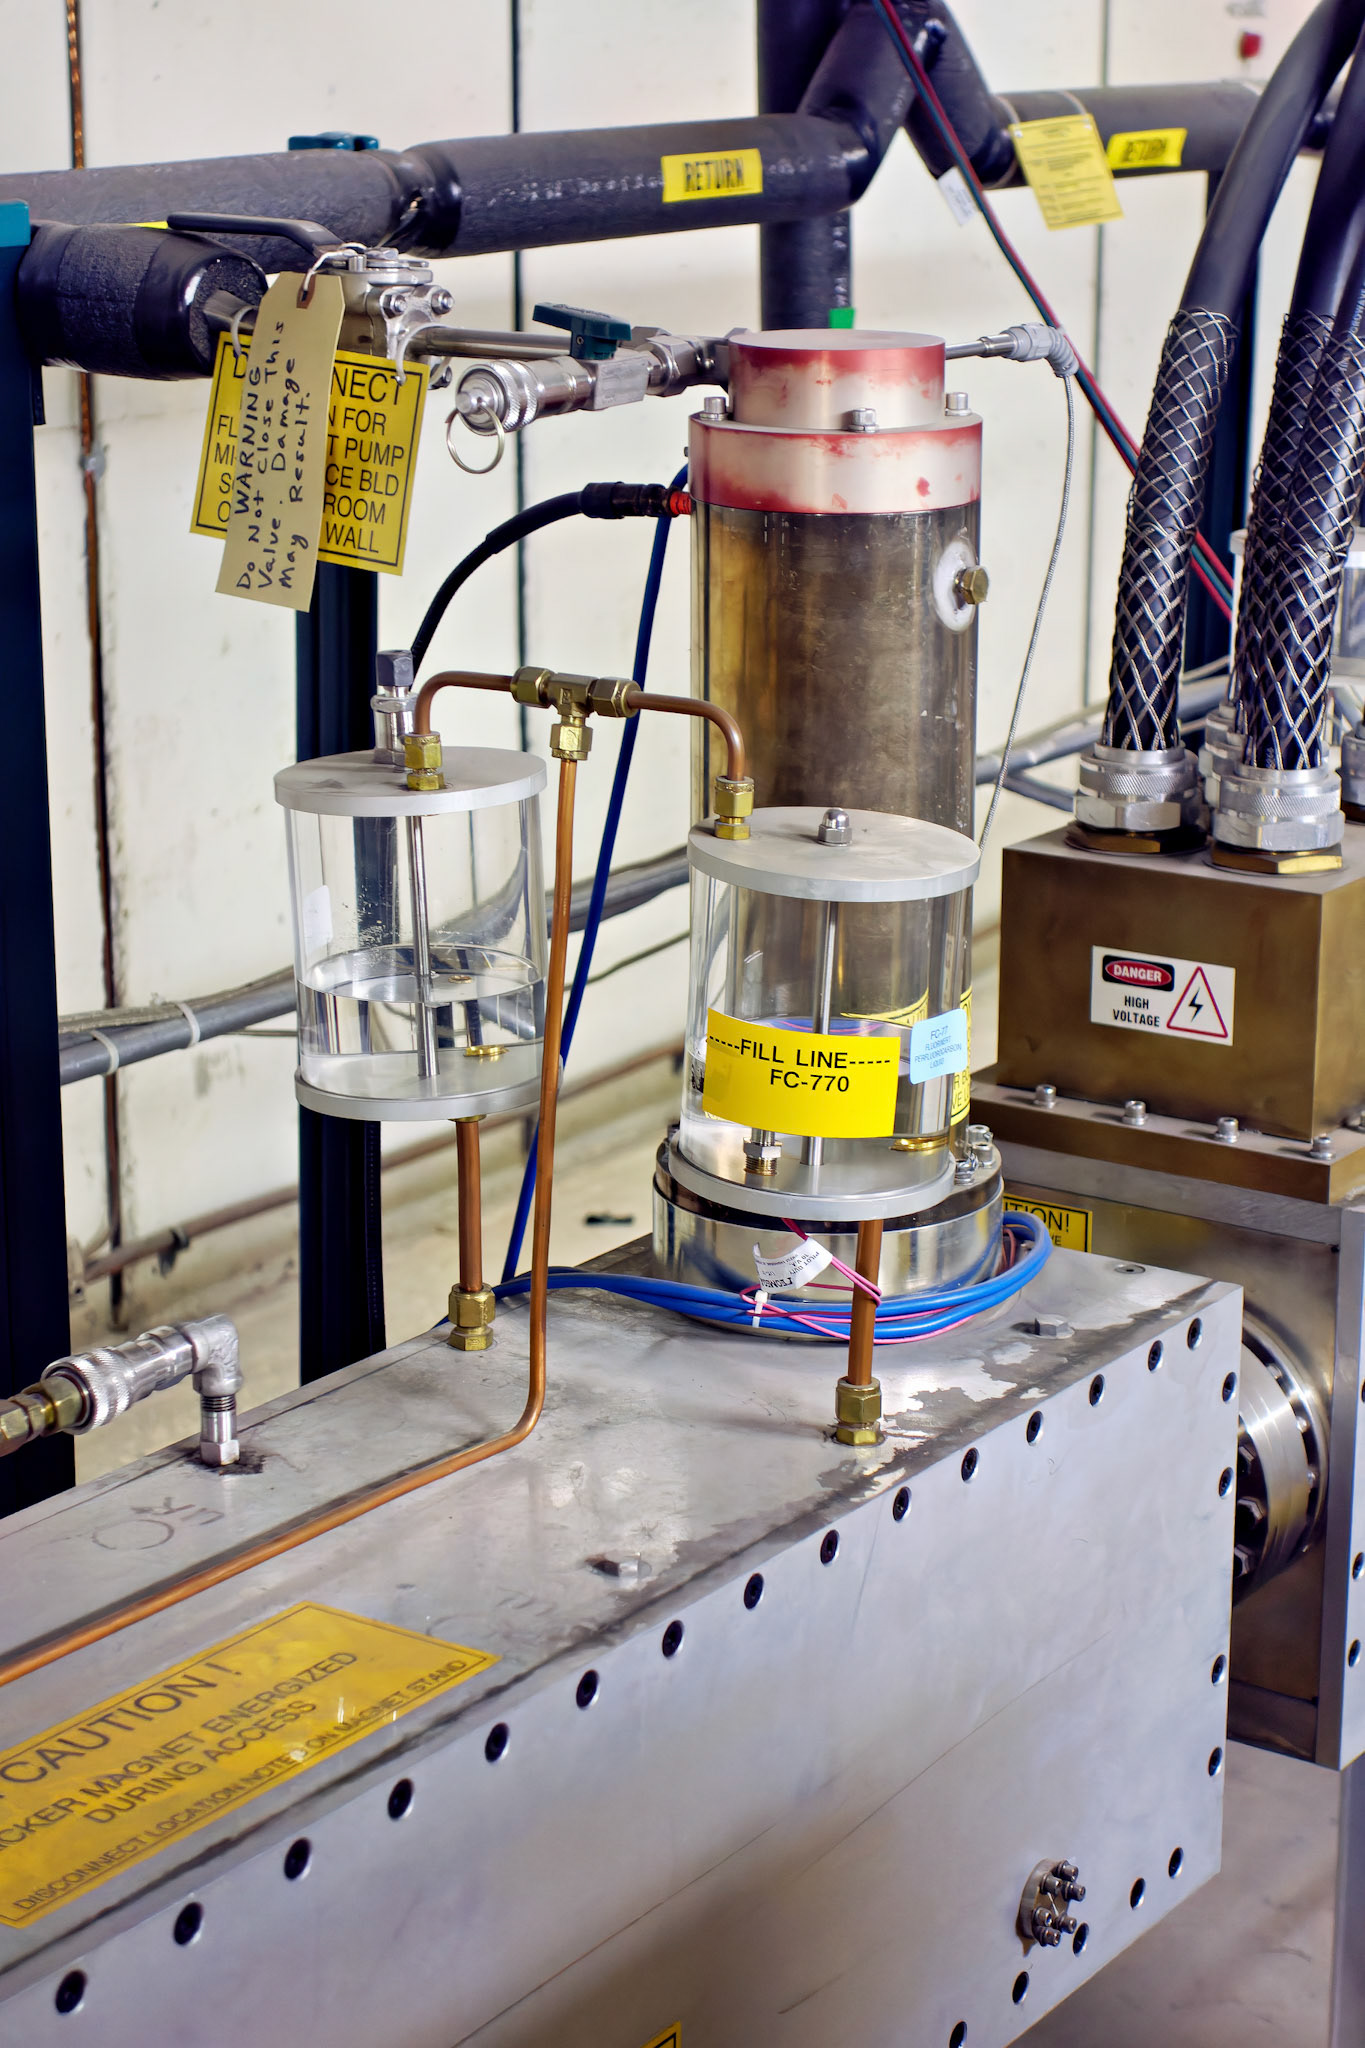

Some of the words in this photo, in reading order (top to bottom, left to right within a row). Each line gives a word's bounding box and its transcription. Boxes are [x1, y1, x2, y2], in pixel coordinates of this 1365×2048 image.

[684, 157, 745, 192] RETURN
[264, 321, 284, 384] This
[271, 358, 300, 471] Damage
[343, 407, 387, 436] FOR
[235, 366, 261, 515] WARNING
[257, 399, 274, 474] Close
[345, 437, 405, 467] PUMP
[359, 469, 400, 497] BLD
[248, 489, 265, 543] Not
[322, 492, 387, 525] ROOM
[325, 521, 380, 554] WALL
[236, 561, 256, 589] Do
[279, 533, 310, 589] May
[1113, 964, 1162, 983] DANGER
[1112, 1008, 1160, 1028] VOLTAGE
[1124, 995, 1150, 1010] HIGH
[930, 1025, 949, 1040] FC-77
[770, 1068, 850, 1093] FC-770
[79, 1731, 206, 1799] MAGNET
[201, 1652, 358, 1734] ENERGIZED
[83, 1760, 208, 1824] DURING
[203, 1700, 317, 1763] ACCESS
[13, 1836, 147, 1911] DISCONNECT
[144, 1778, 246, 1840] LOCATION
[304, 1732, 337, 1751] ON
[406, 1659, 468, 1694] STAND
